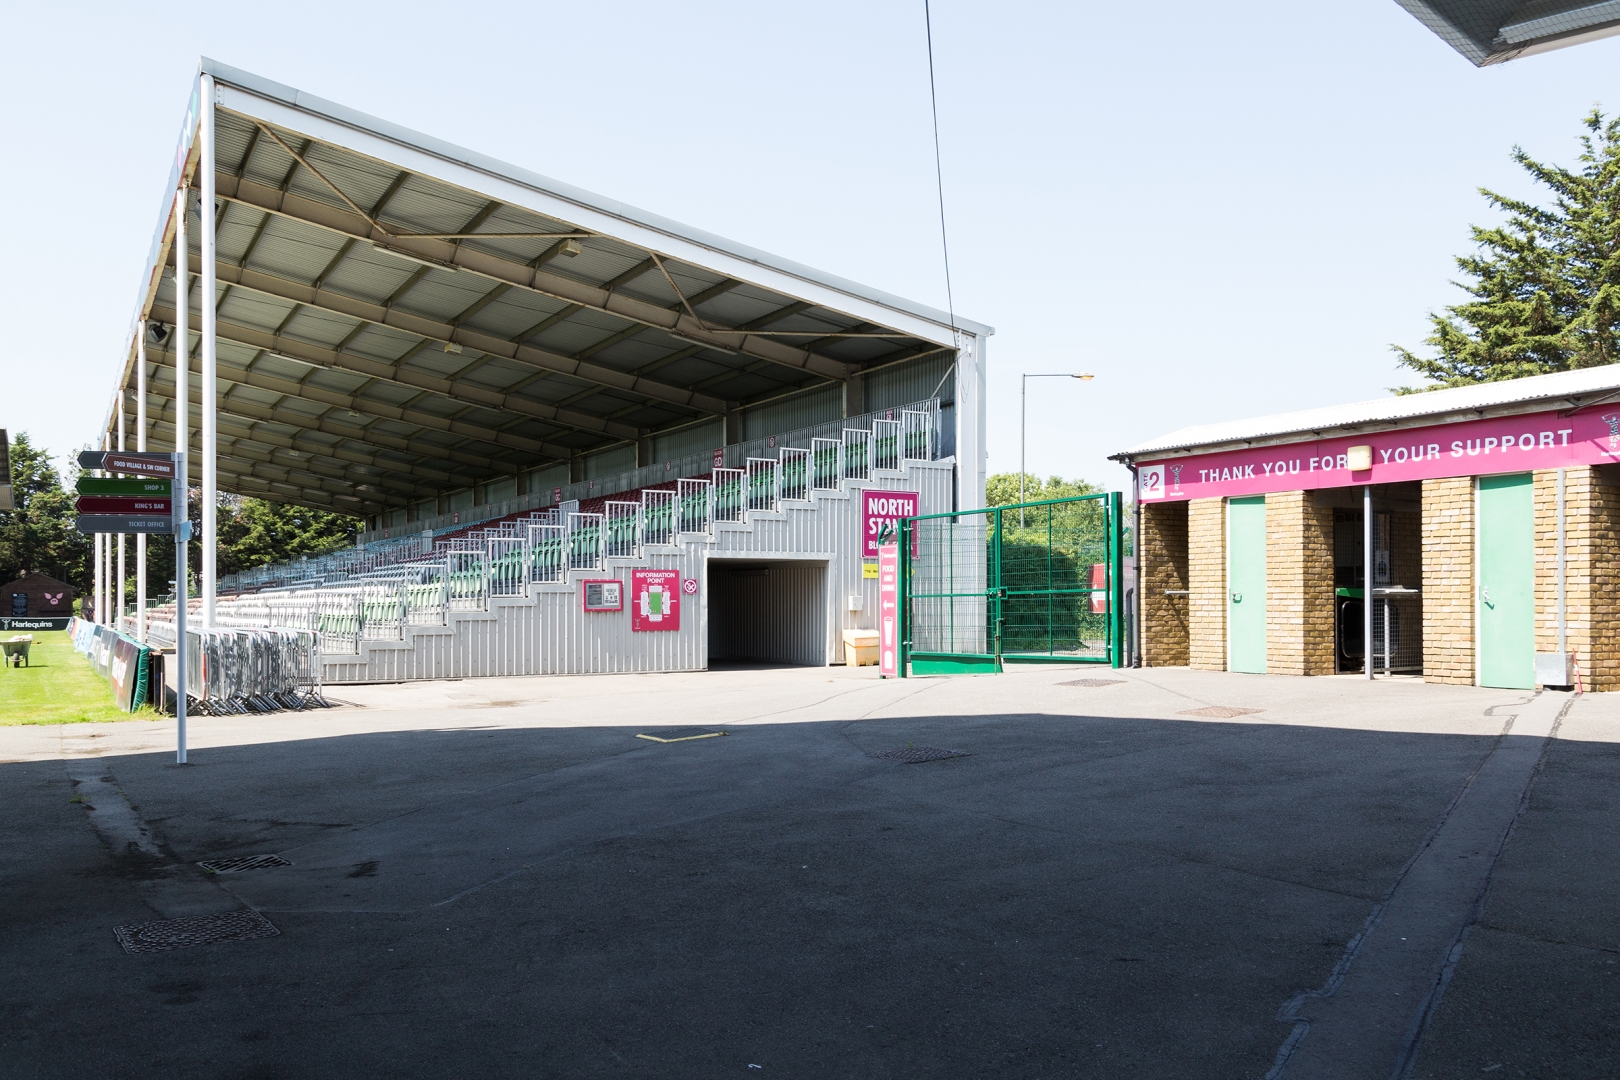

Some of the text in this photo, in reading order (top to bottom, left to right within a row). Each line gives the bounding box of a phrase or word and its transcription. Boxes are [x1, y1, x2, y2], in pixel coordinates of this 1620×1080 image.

[1199, 430, 1572, 482] THANK YOU FOR YOUR SUPPORT
[1149, 472, 1160, 492] 2
[868, 498, 914, 516] NORTH
[868, 518, 910, 534] STAN
[11, 620, 52, 628] Harlequins
